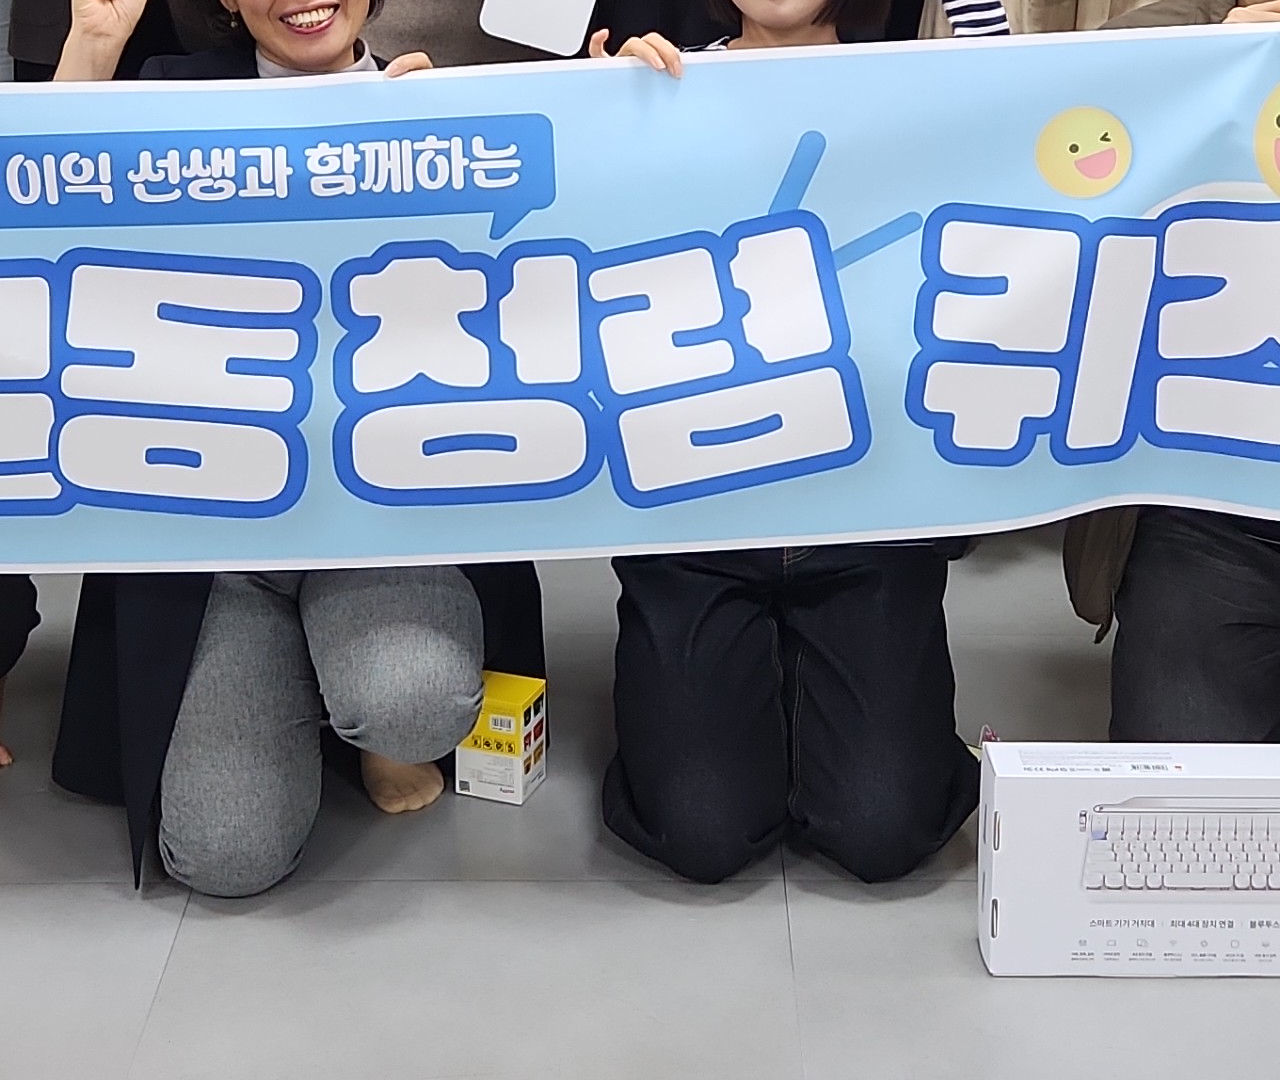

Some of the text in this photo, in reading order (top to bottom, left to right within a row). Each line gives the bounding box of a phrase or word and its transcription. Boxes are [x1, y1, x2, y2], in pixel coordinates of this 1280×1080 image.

[5, 152, 115, 207] 이익
[128, 145, 294, 204] 선생과
[305, 134, 523, 195] 함께하는
[338, 216, 864, 502] 청렴
[1089, 919, 1112, 928] 스마트
[1170, 920, 1185, 929] 최대
[1249, 920, 1280, 929] 블루투스
